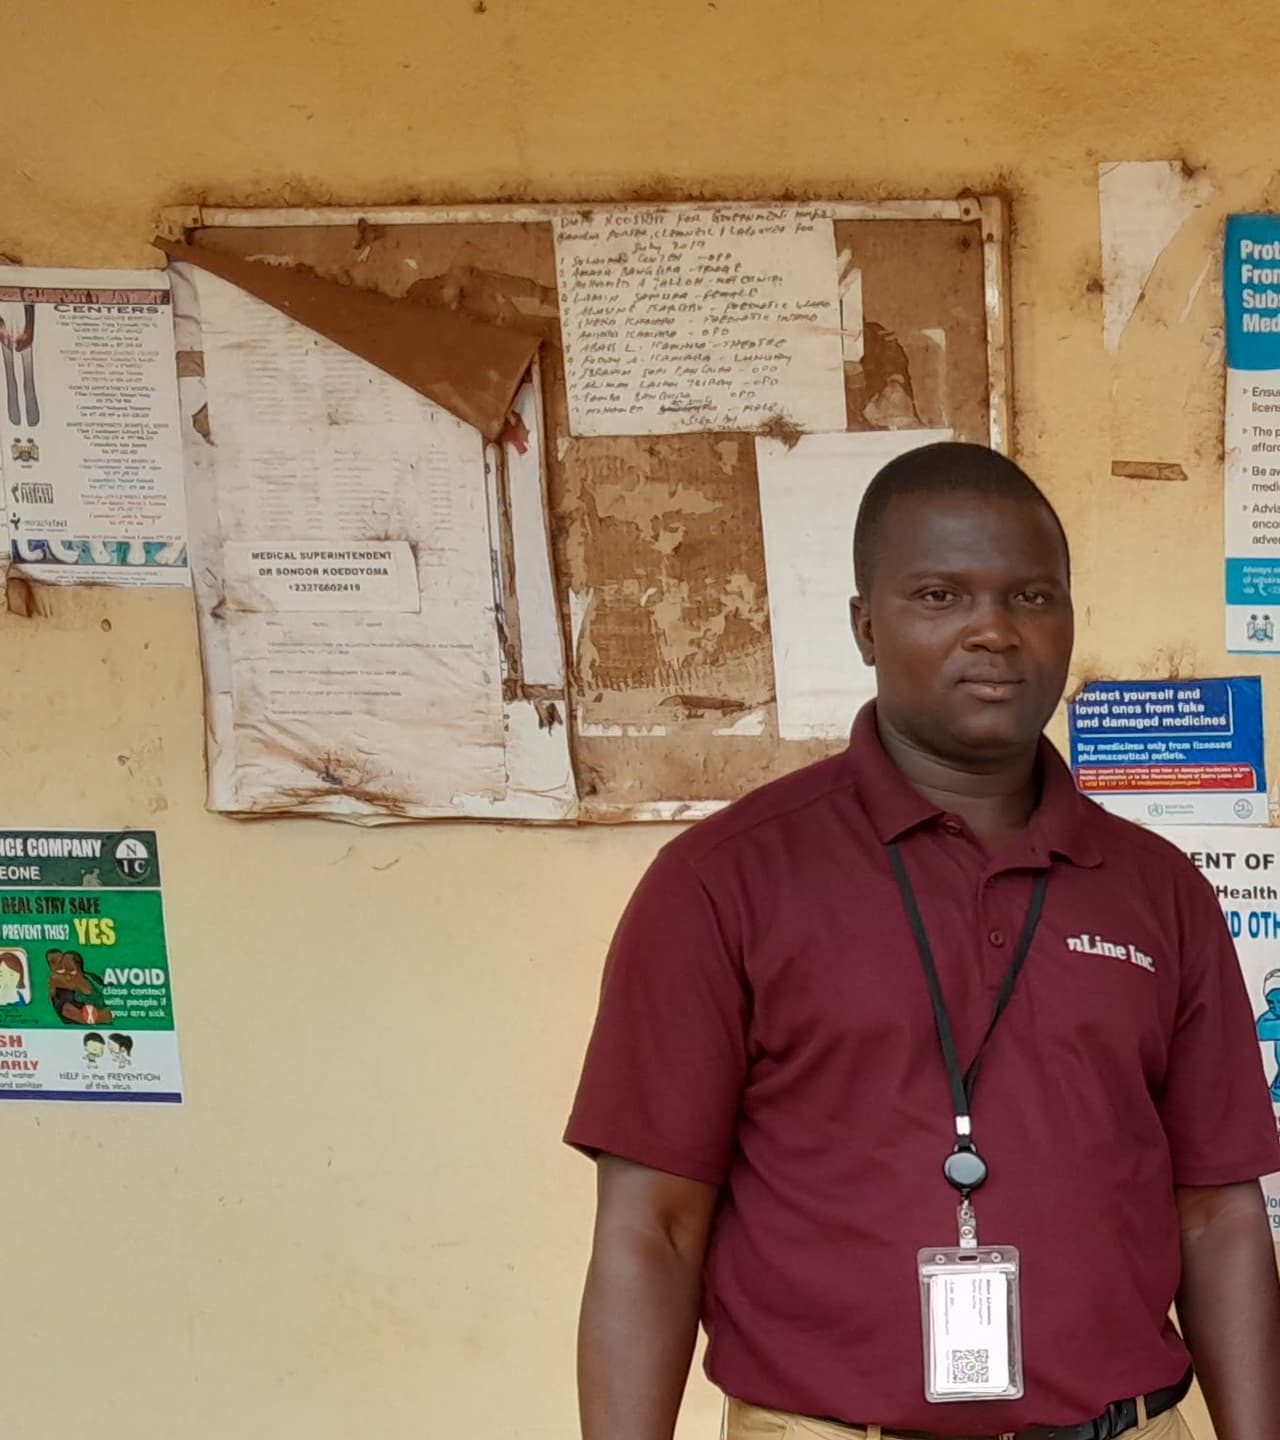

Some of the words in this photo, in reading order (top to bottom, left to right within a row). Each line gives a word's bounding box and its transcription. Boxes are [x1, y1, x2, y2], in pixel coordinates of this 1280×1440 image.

[1251, 426, 1273, 437] The
[1252, 466, 1267, 476] Be
[251, 552, 297, 560] MEDICAL
[300, 552, 392, 560] SUPERINTENDENT
[1123, 689, 1174, 702] yourself
[1177, 688, 1200, 700] and
[1076, 703, 1108, 715] loved
[1112, 705, 1142, 715] ones
[1145, 703, 1174, 714] from
[1178, 701, 1205, 713] fake
[1076, 717, 1099, 728] and
[1102, 716, 1159, 729] damaged
[1163, 714, 1226, 727] medicines
[1077, 743, 1095, 753] Buy
[1147, 742, 1167, 752] only
[1169, 741, 1190, 750] from
[27, 838, 101, 858] COMPANY
[1187, 852, 1236, 869] ENT
[1245, 854, 1275, 870] OF
[1215, 886, 1277, 900] Health
[36, 897, 66, 914] STAY
[70, 897, 101, 914] SAFE
[2, 924, 42, 940] PREVENT
[44, 924, 69, 940] THIS?
[74, 918, 116, 945] YES
[1066, 934, 1127, 960] nLine
[103, 968, 165, 985] AVOID
[103, 987, 128, 996] close
[131, 987, 165, 996] contact
[127, 998, 157, 1007] people
[149, 1009, 165, 1018] sick
